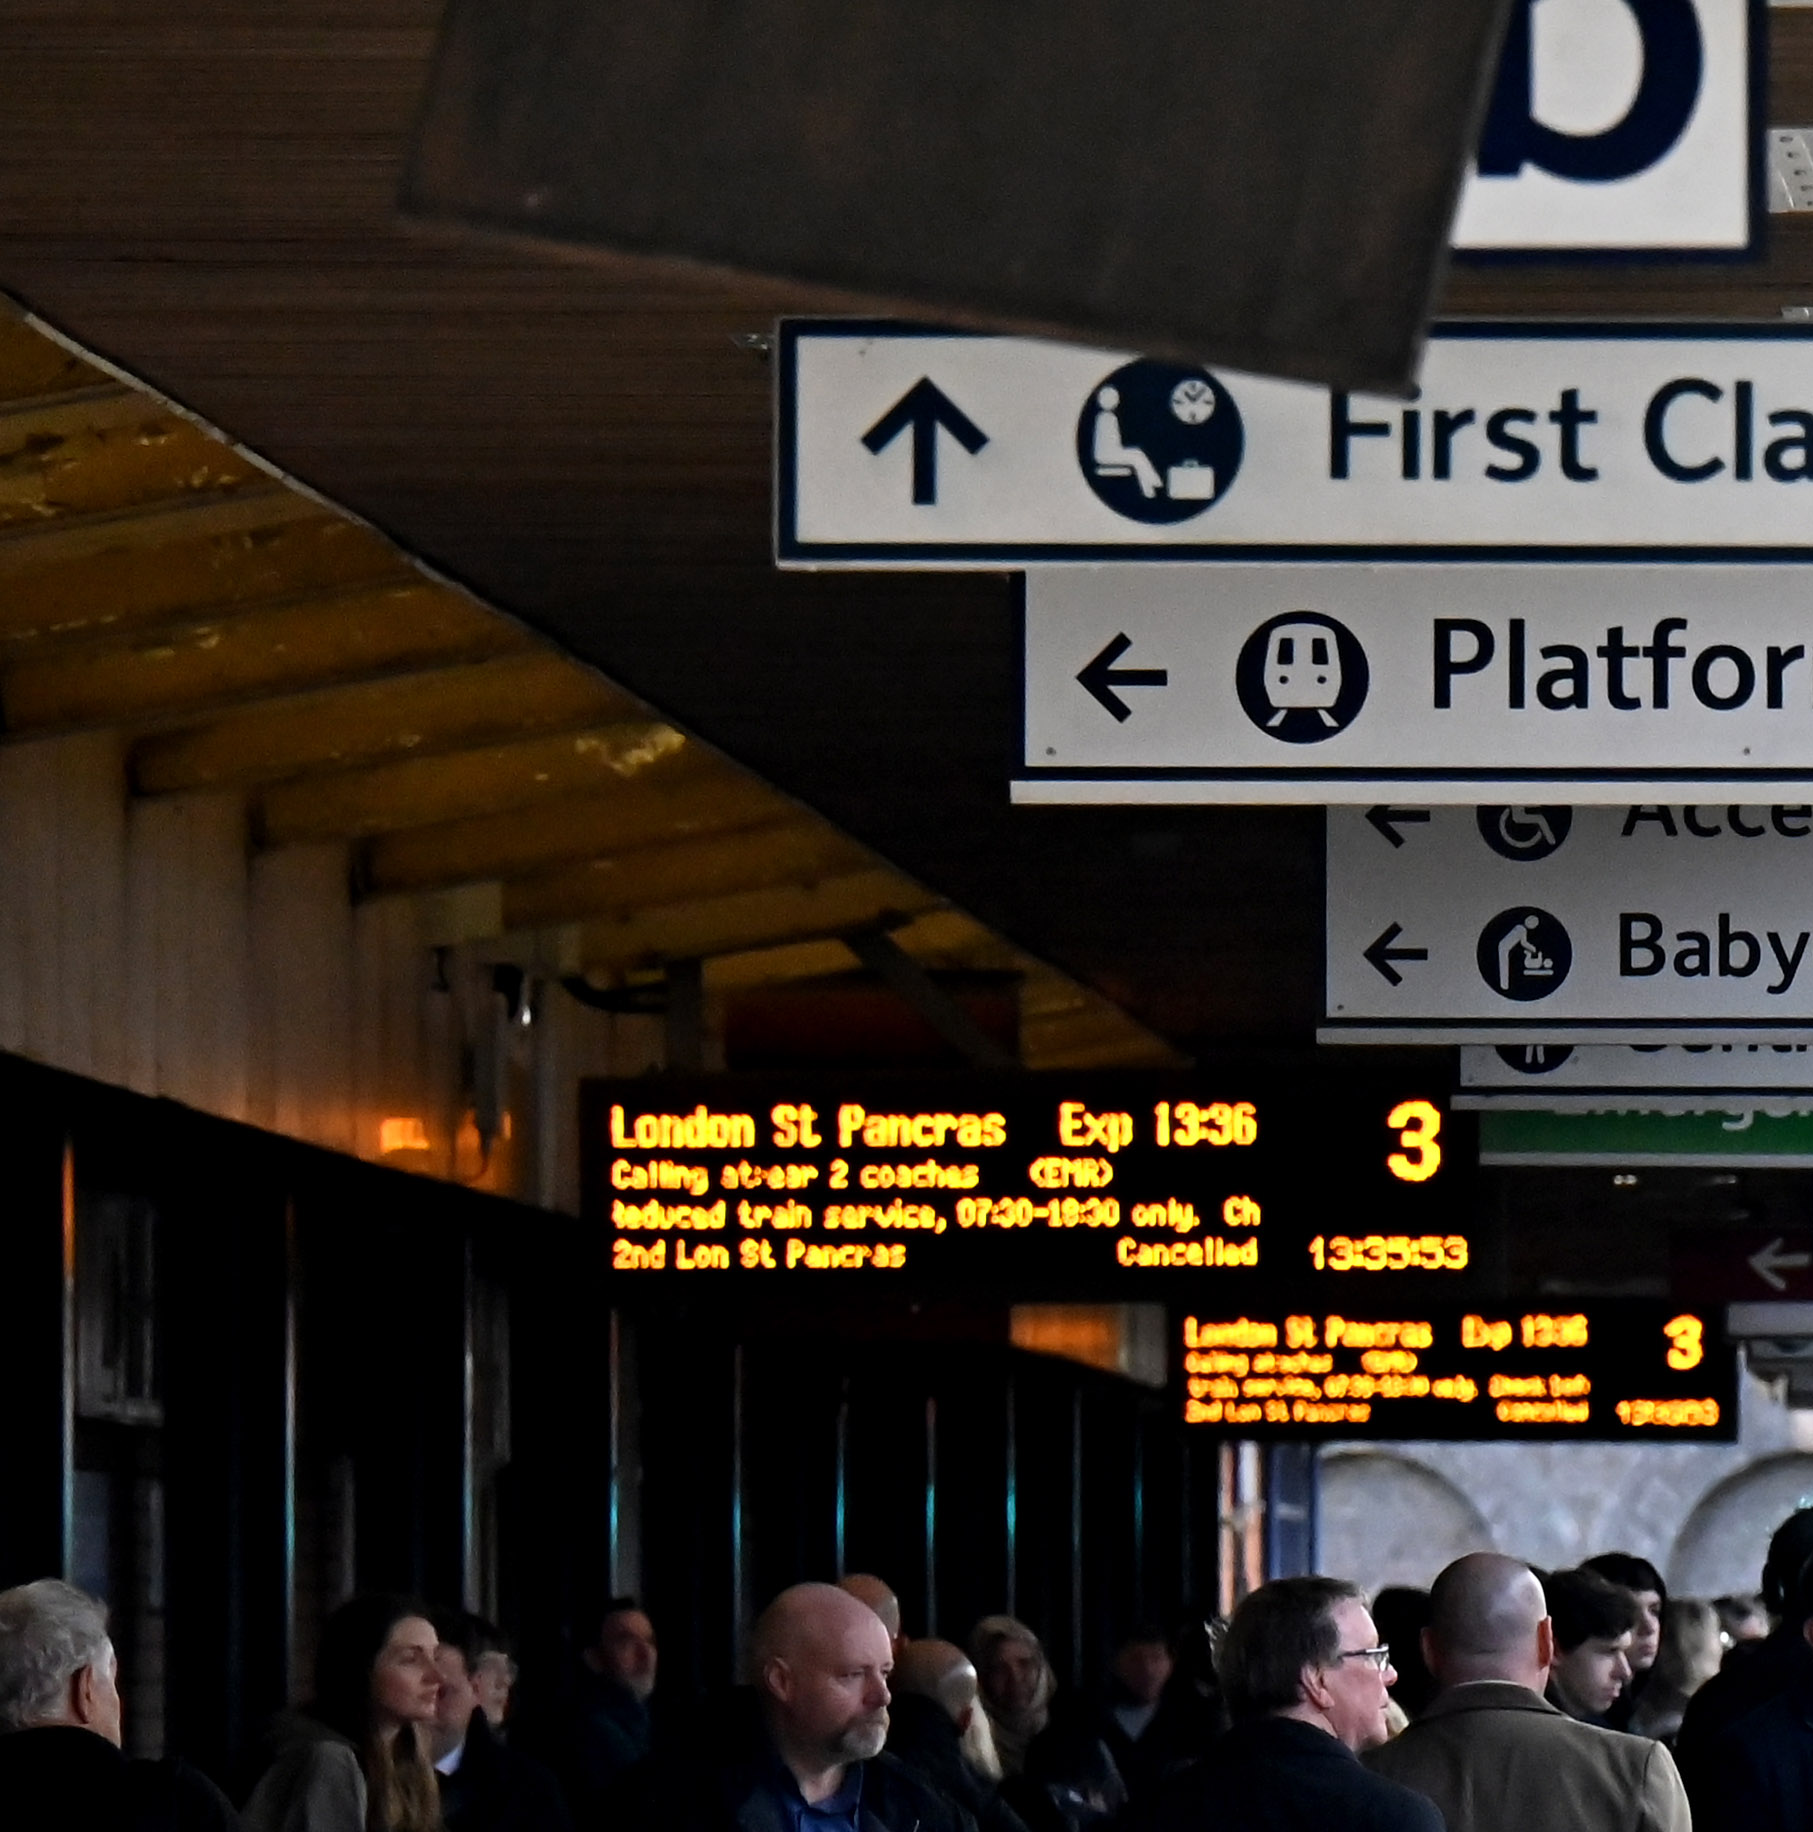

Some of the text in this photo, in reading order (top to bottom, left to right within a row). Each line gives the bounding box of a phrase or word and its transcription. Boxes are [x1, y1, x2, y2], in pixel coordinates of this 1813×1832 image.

[1329, 386, 1600, 485] First
[608, 1100, 1259, 1154] London St Pancras Exp 13:36
[1386, 1098, 1442, 1183] 3
[610, 1157, 711, 1197] Calling
[828, 1157, 850, 1190] 2
[858, 1157, 981, 1190] coaches
[735, 1197, 814, 1231] train
[1222, 1195, 1263, 1228] Ch
[611, 1235, 1260, 1271] 2nd Lon St Pancras Cancelled
[1307, 1234, 1470, 1272] 13:35:53
[1662, 1313, 1705, 1371] 3
